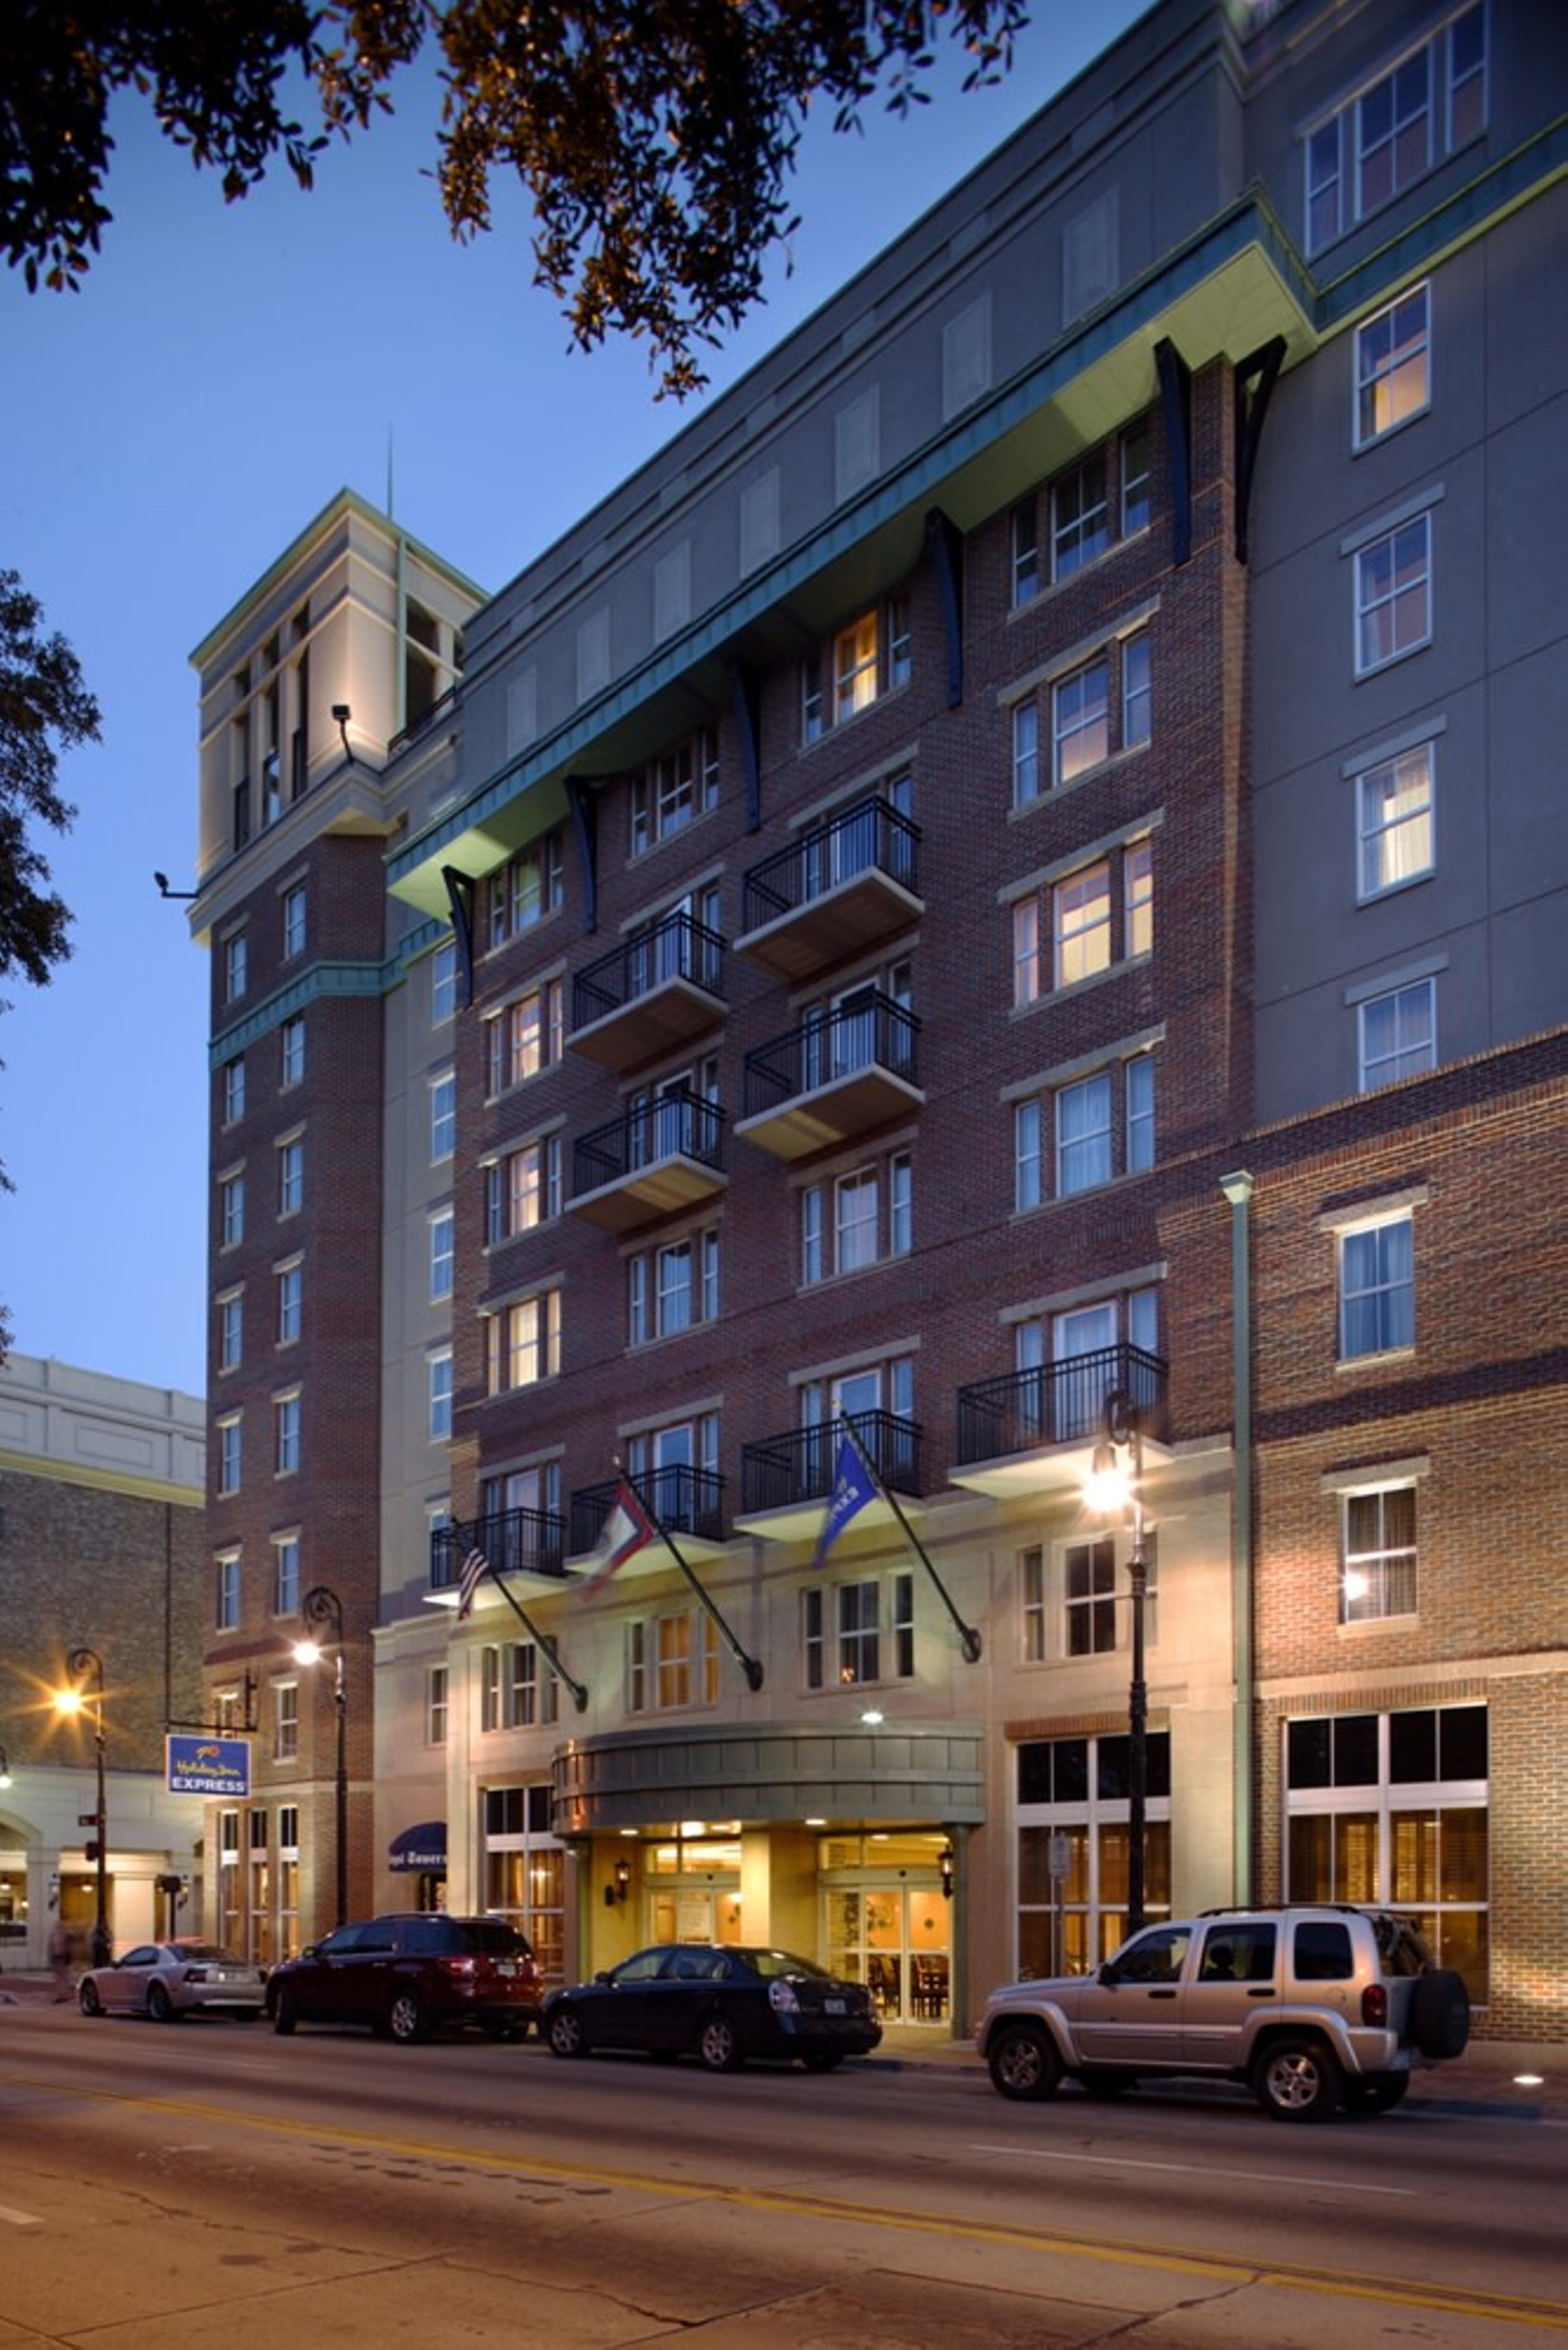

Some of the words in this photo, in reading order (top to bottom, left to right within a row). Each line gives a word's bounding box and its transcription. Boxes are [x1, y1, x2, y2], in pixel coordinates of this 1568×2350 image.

[177, 1759, 217, 1777] Holiday
[218, 1764, 240, 1776] Inn
[172, 1777, 245, 1793] EXPRESS
